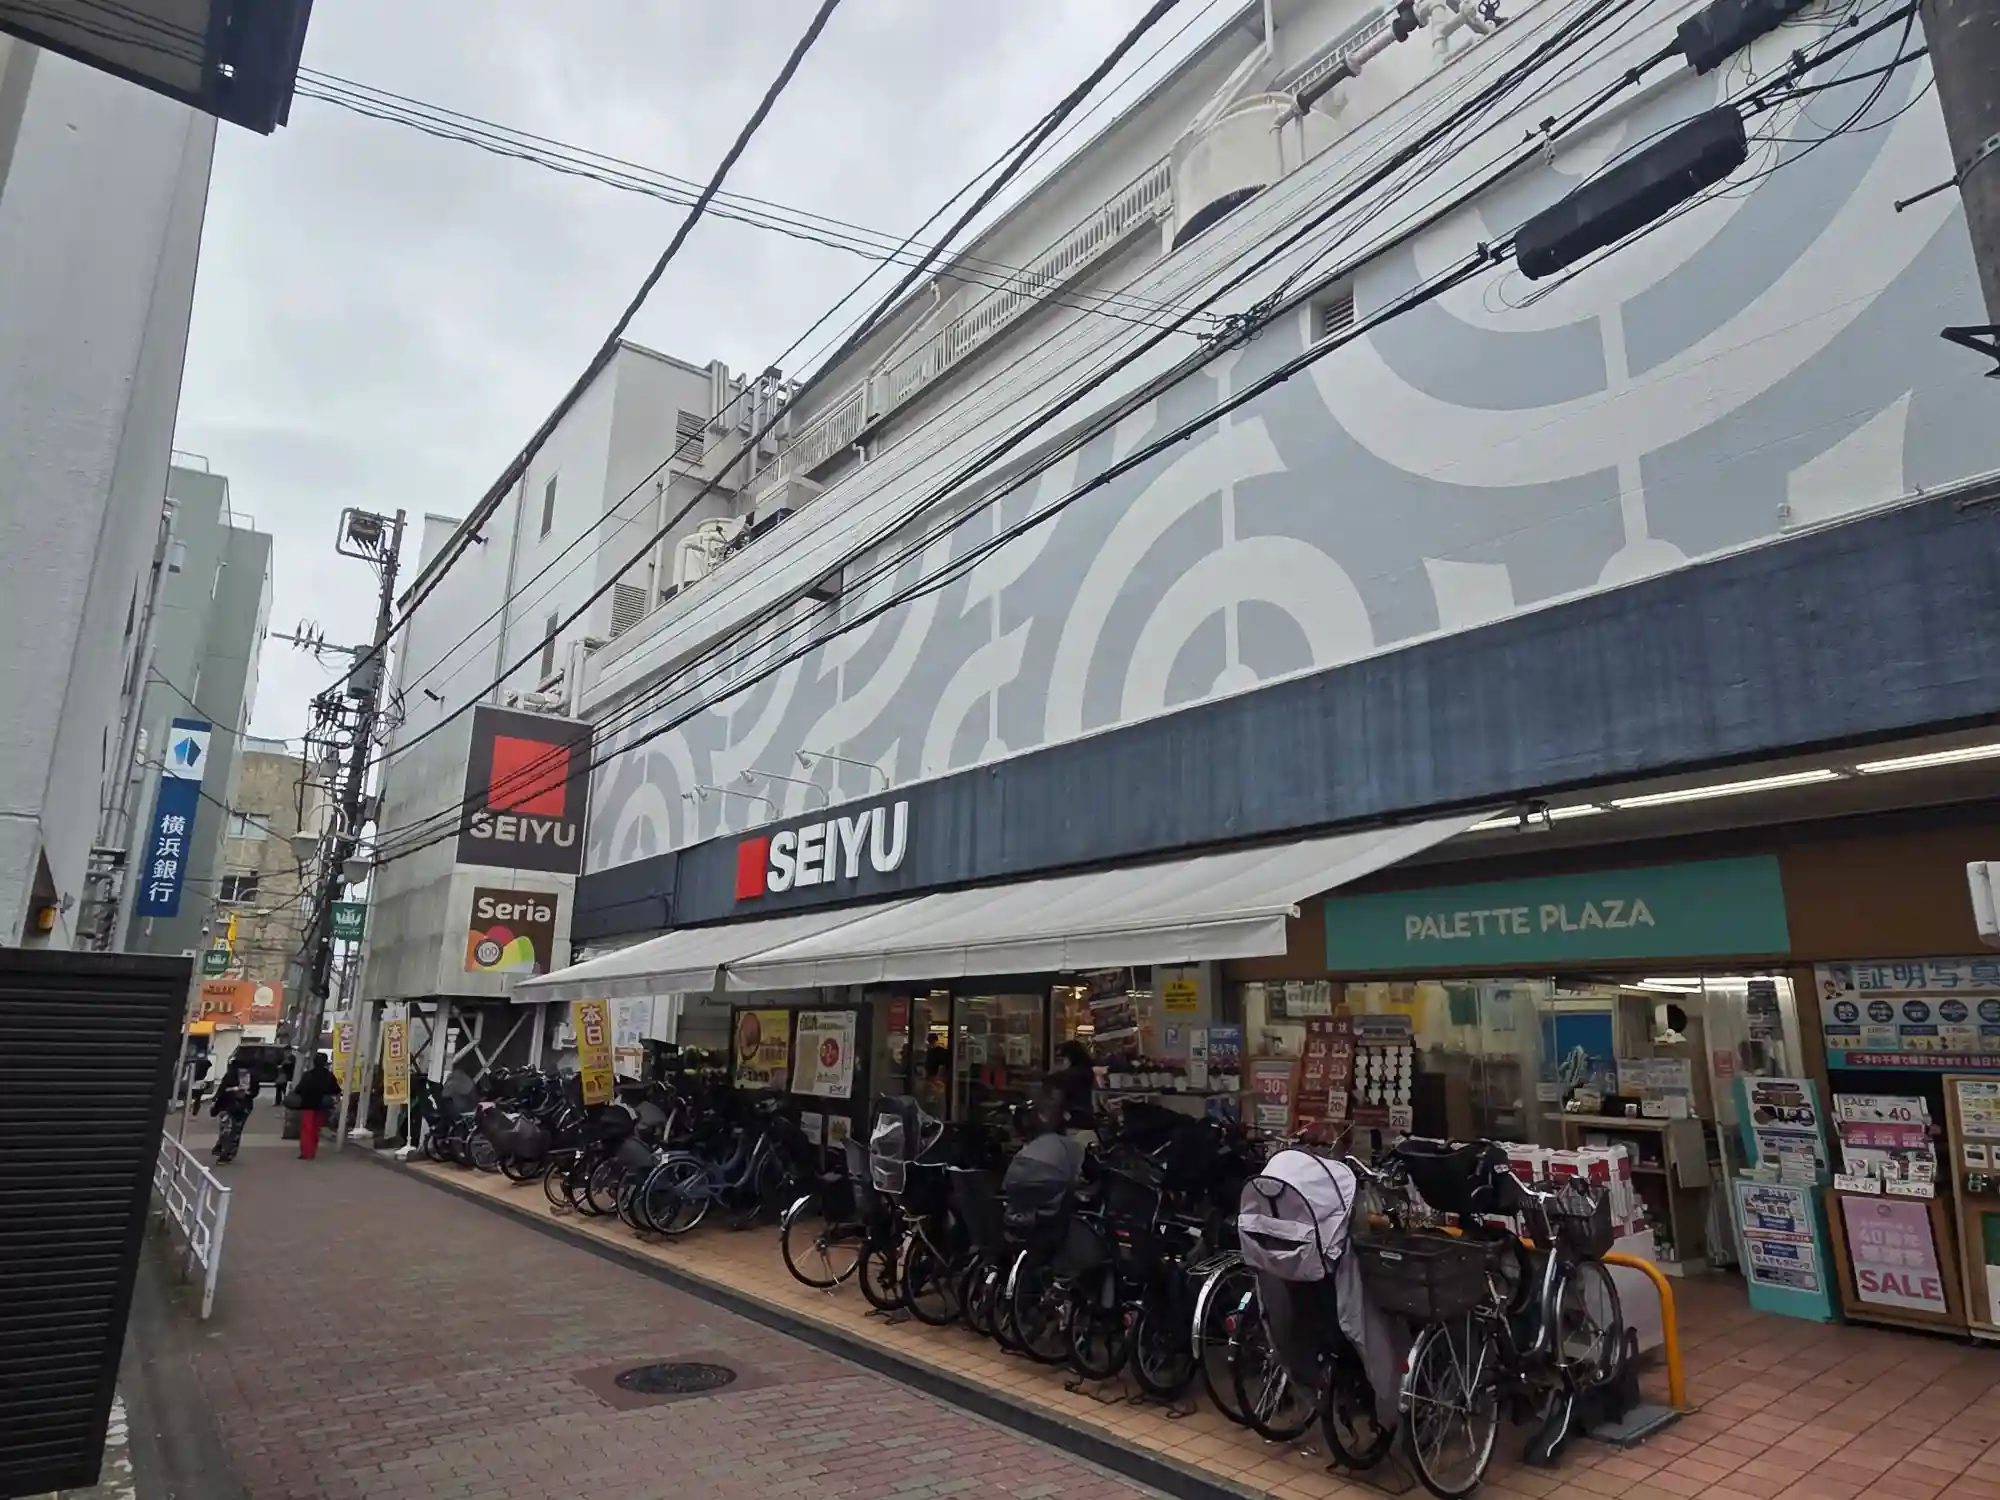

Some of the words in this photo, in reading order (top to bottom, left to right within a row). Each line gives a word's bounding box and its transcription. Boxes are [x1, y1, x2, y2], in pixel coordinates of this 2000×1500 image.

[469, 809, 576, 848] SEIYU
[766, 801, 909, 893] SEIYU
[148, 814, 187, 903] 横浜銀行
[477, 896, 551, 923] Seria
[1405, 907, 1531, 941] PALETTE
[1539, 898, 1656, 933] PLAZA
[479, 946, 499, 958] 100
[1856, 960, 2000, 989] 証明写真
[581, 1005, 603, 1045] 本日
[1859, 1269, 1942, 1300] SALE
